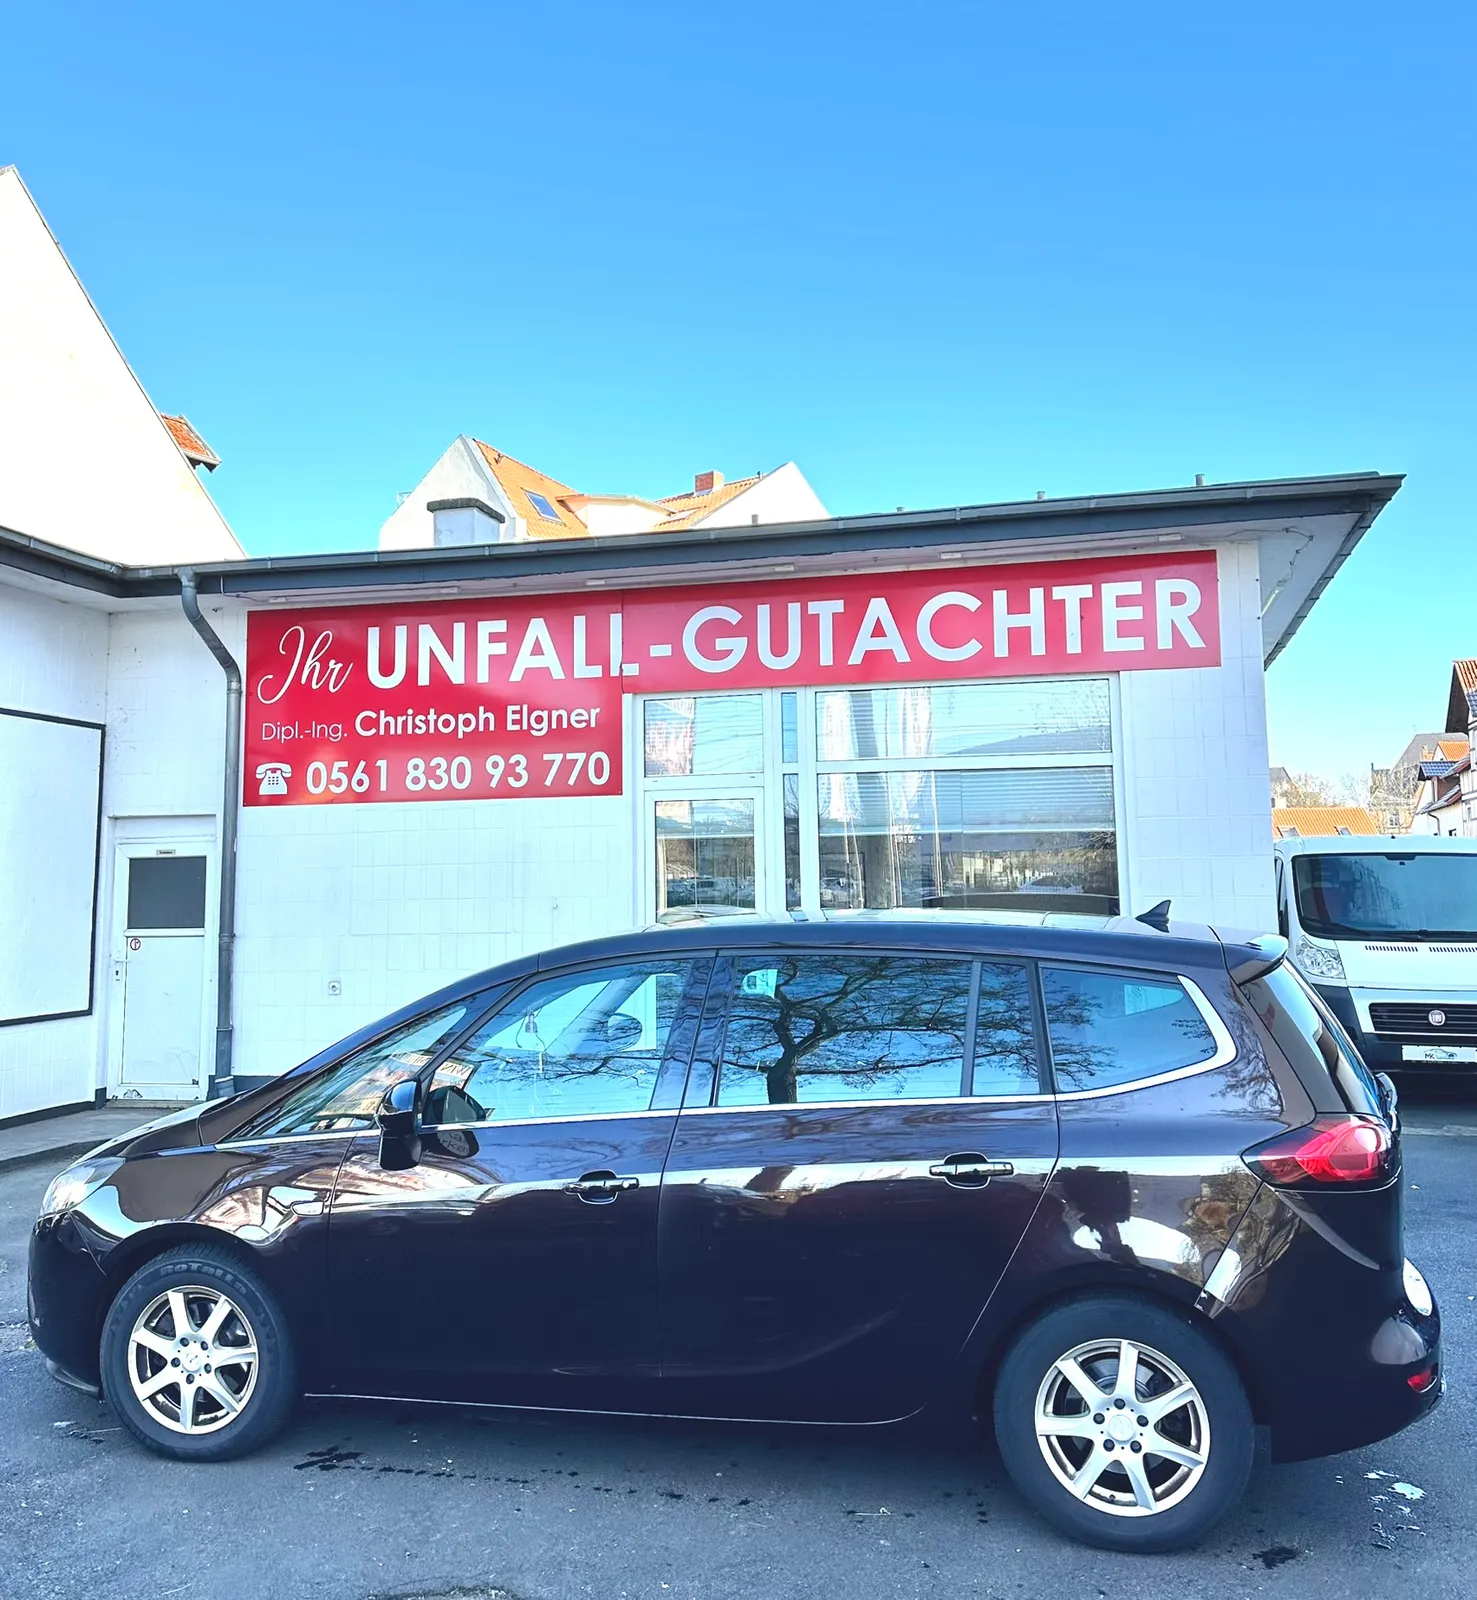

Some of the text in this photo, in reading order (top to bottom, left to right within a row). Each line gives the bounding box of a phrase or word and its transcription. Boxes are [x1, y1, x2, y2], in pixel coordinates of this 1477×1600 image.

[257, 625, 354, 705] Ihr
[262, 704, 601, 744] Dipl.-Ing. Christoph Elgner
[306, 751, 611, 795] 0561 830 93 770
